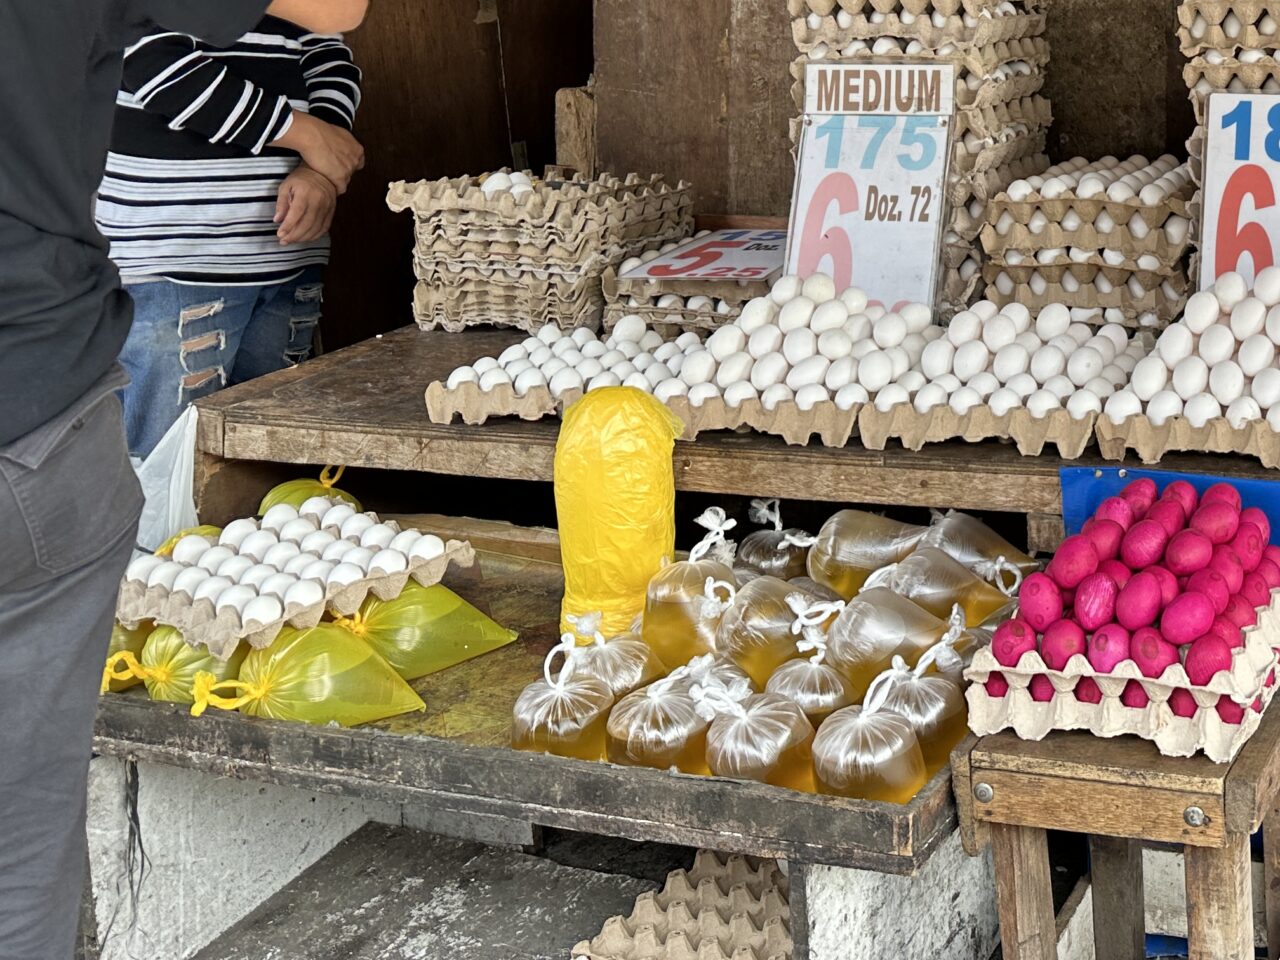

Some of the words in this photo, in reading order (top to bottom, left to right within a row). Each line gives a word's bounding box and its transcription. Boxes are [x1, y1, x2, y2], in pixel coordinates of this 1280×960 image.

[816, 69, 942, 113] MEDIUM
[815, 114, 939, 171] 175
[864, 184, 902, 222] Doz.
[909, 185, 932, 223] 72
[1214, 163, 1276, 281] 6
[797, 171, 860, 298] 6
